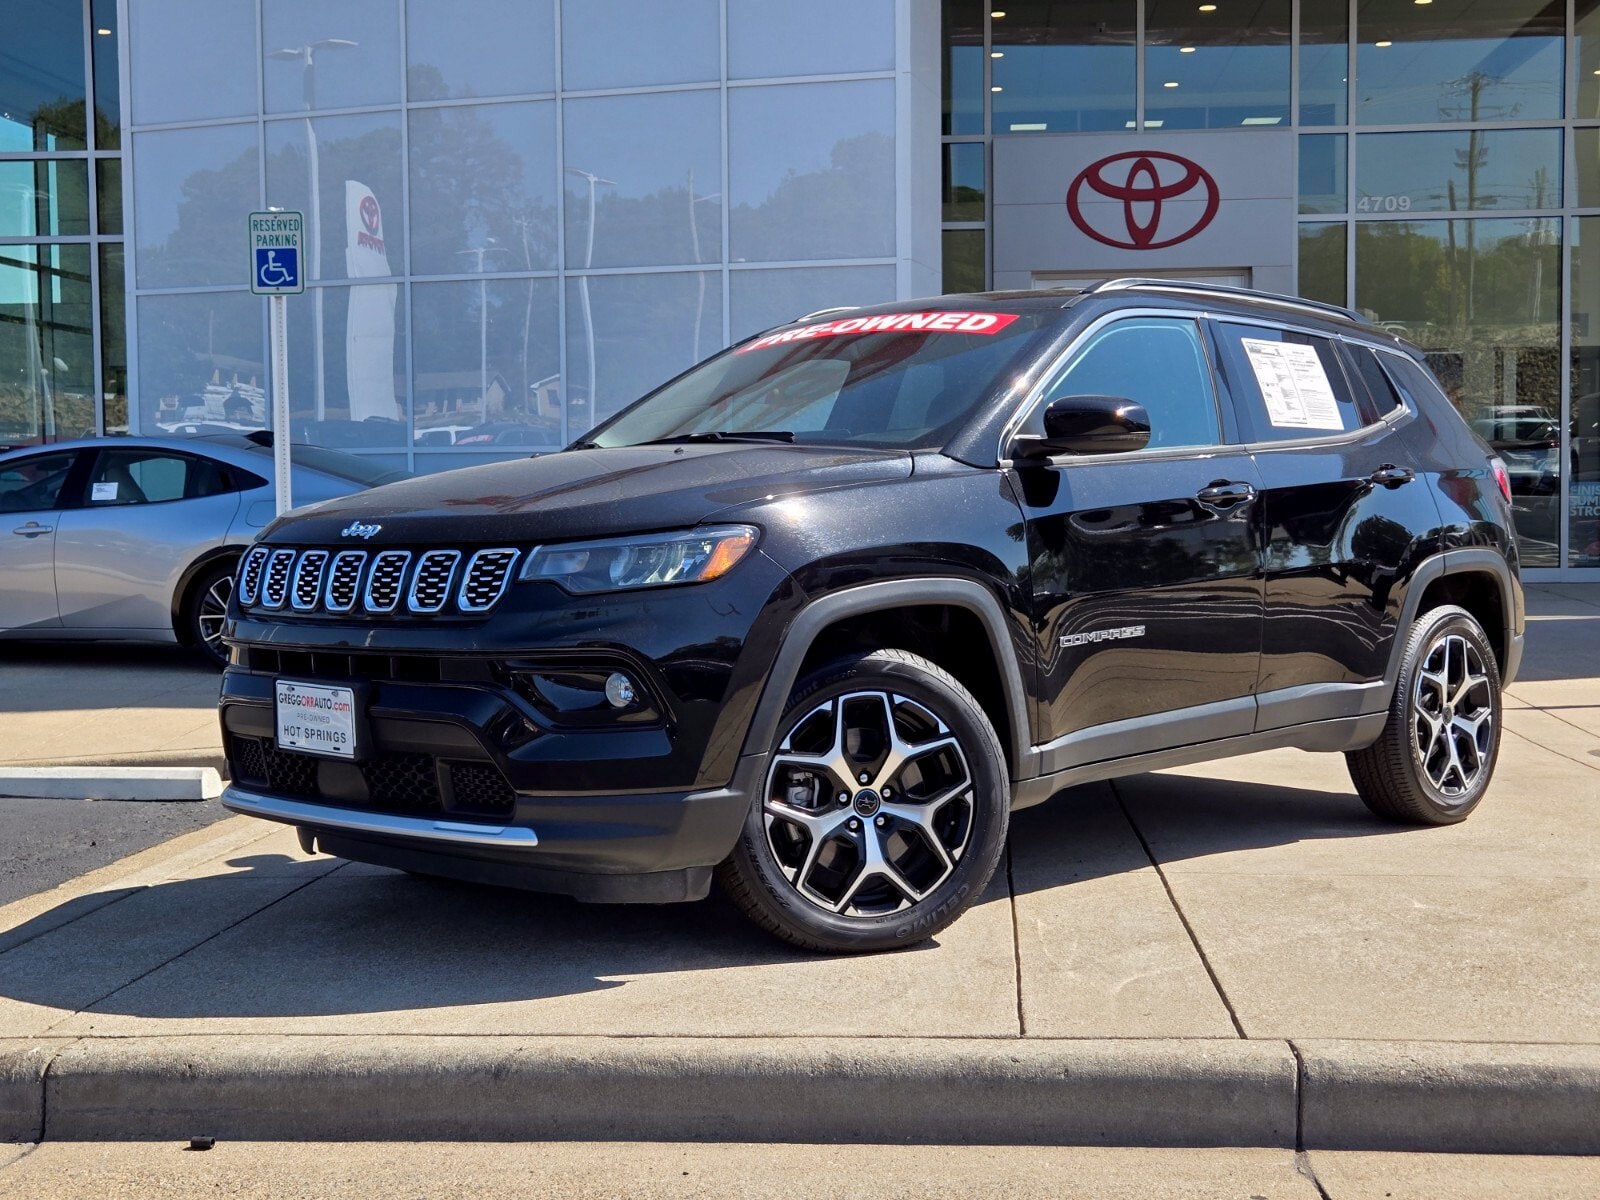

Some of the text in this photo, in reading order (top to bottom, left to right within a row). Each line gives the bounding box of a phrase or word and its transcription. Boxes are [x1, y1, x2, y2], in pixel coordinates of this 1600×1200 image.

[1357, 195, 1411, 212] 4709
[253, 219, 300, 232] RESERVED
[256, 234, 298, 247] PARKING
[747, 312, 998, 351] PRE-OWNED
[341, 520, 382, 540] Jeep
[1059, 625, 1146, 648] COMPASS
[278, 692, 350, 712] GREGGORRAUTO.com
[283, 725, 347, 744] HOT SPRINGS
